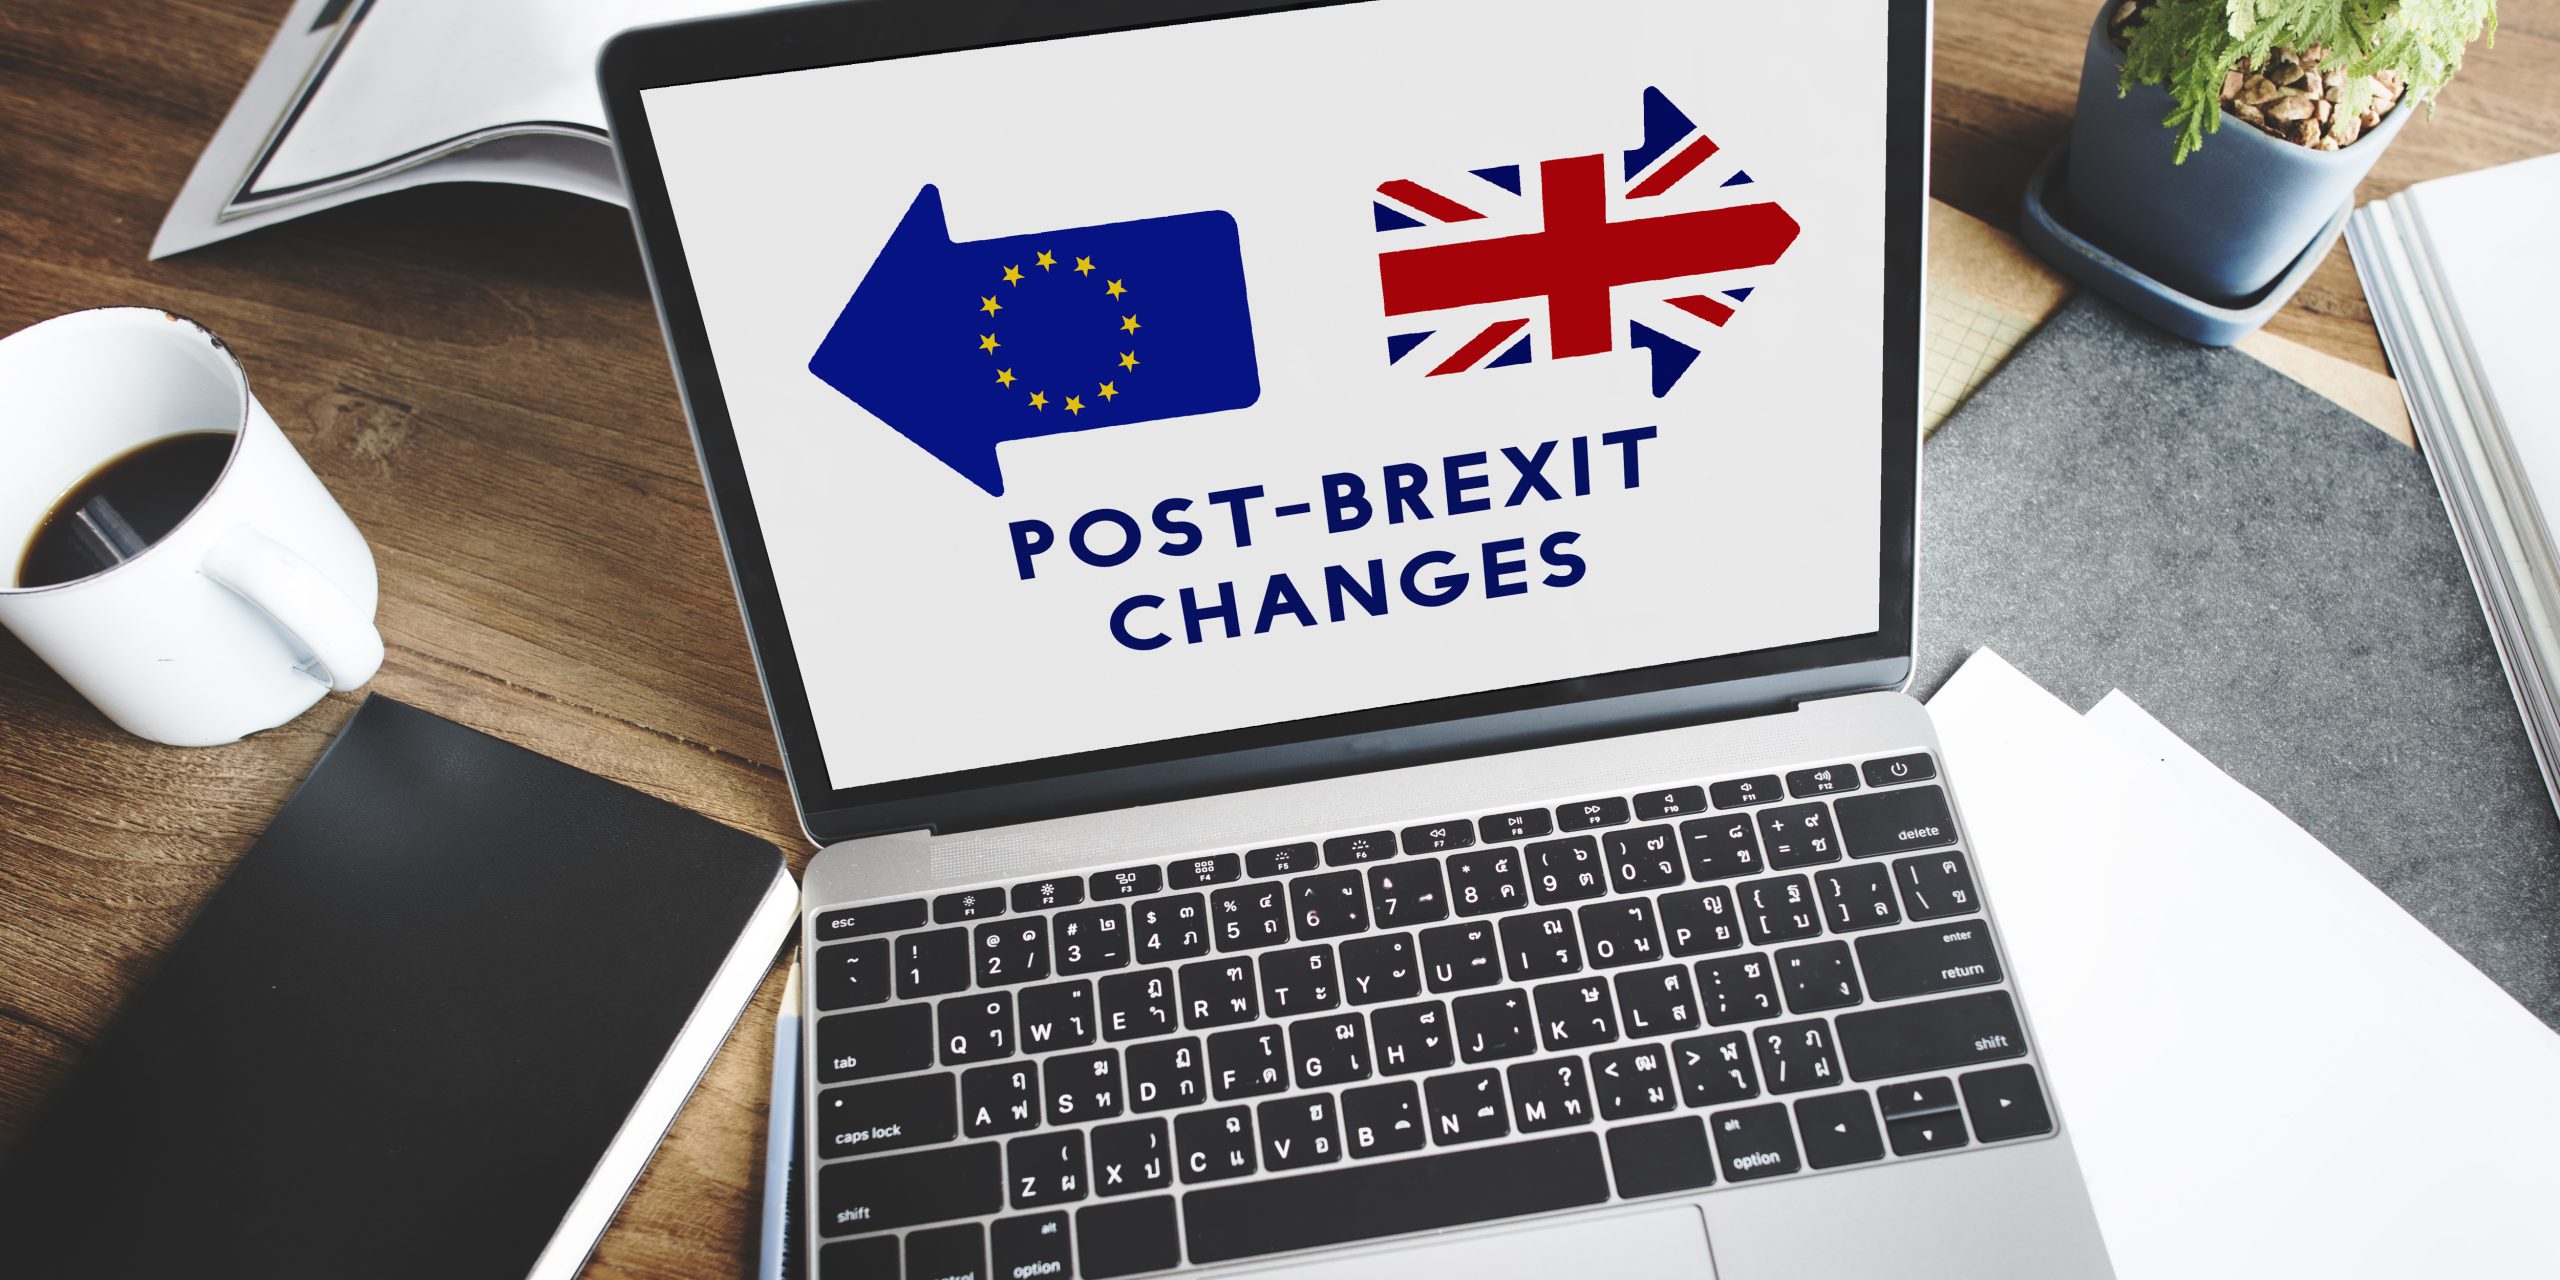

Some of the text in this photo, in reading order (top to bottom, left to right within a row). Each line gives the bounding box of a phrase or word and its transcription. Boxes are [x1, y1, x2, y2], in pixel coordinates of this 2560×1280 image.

[1009, 426, 1657, 581] POST-BREXIT
[1110, 532, 1586, 651] CHANGES
[1818, 782, 1834, 791] F12
[1743, 793, 1756, 802] F11
[1664, 804, 1679, 814] F10
[1590, 815, 1601, 824] F9
[1771, 819, 1785, 832] +
[1512, 827, 1524, 836] F8
[1897, 825, 1941, 841] delete
[1434, 839, 1445, 848] F7
[1619, 841, 1627, 856] )
[1356, 851, 1367, 860] F6
[1541, 852, 1549, 867] (
[1278, 862, 1289, 871] F5
[1621, 863, 1637, 881] 0
[1200, 873, 1211, 882] F4
[1542, 874, 1558, 892] 9
[1120, 884, 1132, 893] F3
[1464, 886, 1479, 904] 8
[1829, 878, 1841, 898] }
[1043, 896, 1054, 905] F2
[1223, 899, 1238, 913] %
[1384, 897, 1397, 916] 7
[1753, 889, 1765, 909] {
[964, 908, 975, 916] F1
[1146, 910, 1157, 925] $
[1306, 909, 1321, 927] 6
[1837, 903, 1851, 923] ]
[831, 917, 855, 929] esc
[1066, 922, 1079, 937] #
[1227, 921, 1241, 939] 5
[1759, 915, 1772, 935] [
[986, 934, 1001, 948] @
[1147, 933, 1162, 950] 4
[1676, 927, 1692, 946] P
[1942, 930, 1972, 943] enter
[1067, 944, 1082, 963] 3
[1597, 939, 1615, 958] O
[988, 956, 1002, 975] 2
[1521, 951, 1529, 970] I
[910, 968, 920, 985] 1
[1435, 963, 1453, 982] U
[1941, 964, 1985, 980] return
[1355, 975, 1371, 994] Y
[1274, 987, 1289, 1006] T
[1193, 999, 1209, 1019] R
[1632, 1008, 1649, 1028] L
[1112, 1011, 1127, 1031] E
[1550, 1020, 1569, 1040] K
[1030, 1022, 1053, 1042] W
[950, 1035, 967, 1055] Q
[1472, 1032, 1484, 1053] J
[1767, 1034, 1783, 1055] ?
[1974, 1034, 2009, 1052] shift
[833, 1055, 857, 1070] tab
[1387, 1044, 1405, 1065] H
[1685, 1050, 1701, 1066] >
[1305, 1057, 1323, 1077] G
[1557, 1066, 1572, 1087] ?
[1604, 1061, 1620, 1078] <
[1222, 1069, 1236, 1090] F
[1139, 1081, 1157, 1102] D
[1058, 1093, 1074, 1114] S
[1524, 1100, 1547, 1122] M
[975, 1106, 992, 1126] A
[1440, 1113, 1460, 1135] N
[1724, 1118, 1742, 1132] alt
[834, 1123, 902, 1145] caps lock
[1357, 1126, 1375, 1148] B
[1273, 1138, 1291, 1159] V
[1190, 1151, 1207, 1173] C
[1732, 1151, 1781, 1171] option
[1106, 1163, 1123, 1185] X
[1021, 1176, 1037, 1198] Z
[836, 1206, 871, 1223] shift
[1040, 1221, 1058, 1235] alt
[1012, 1260, 1062, 1280] option
